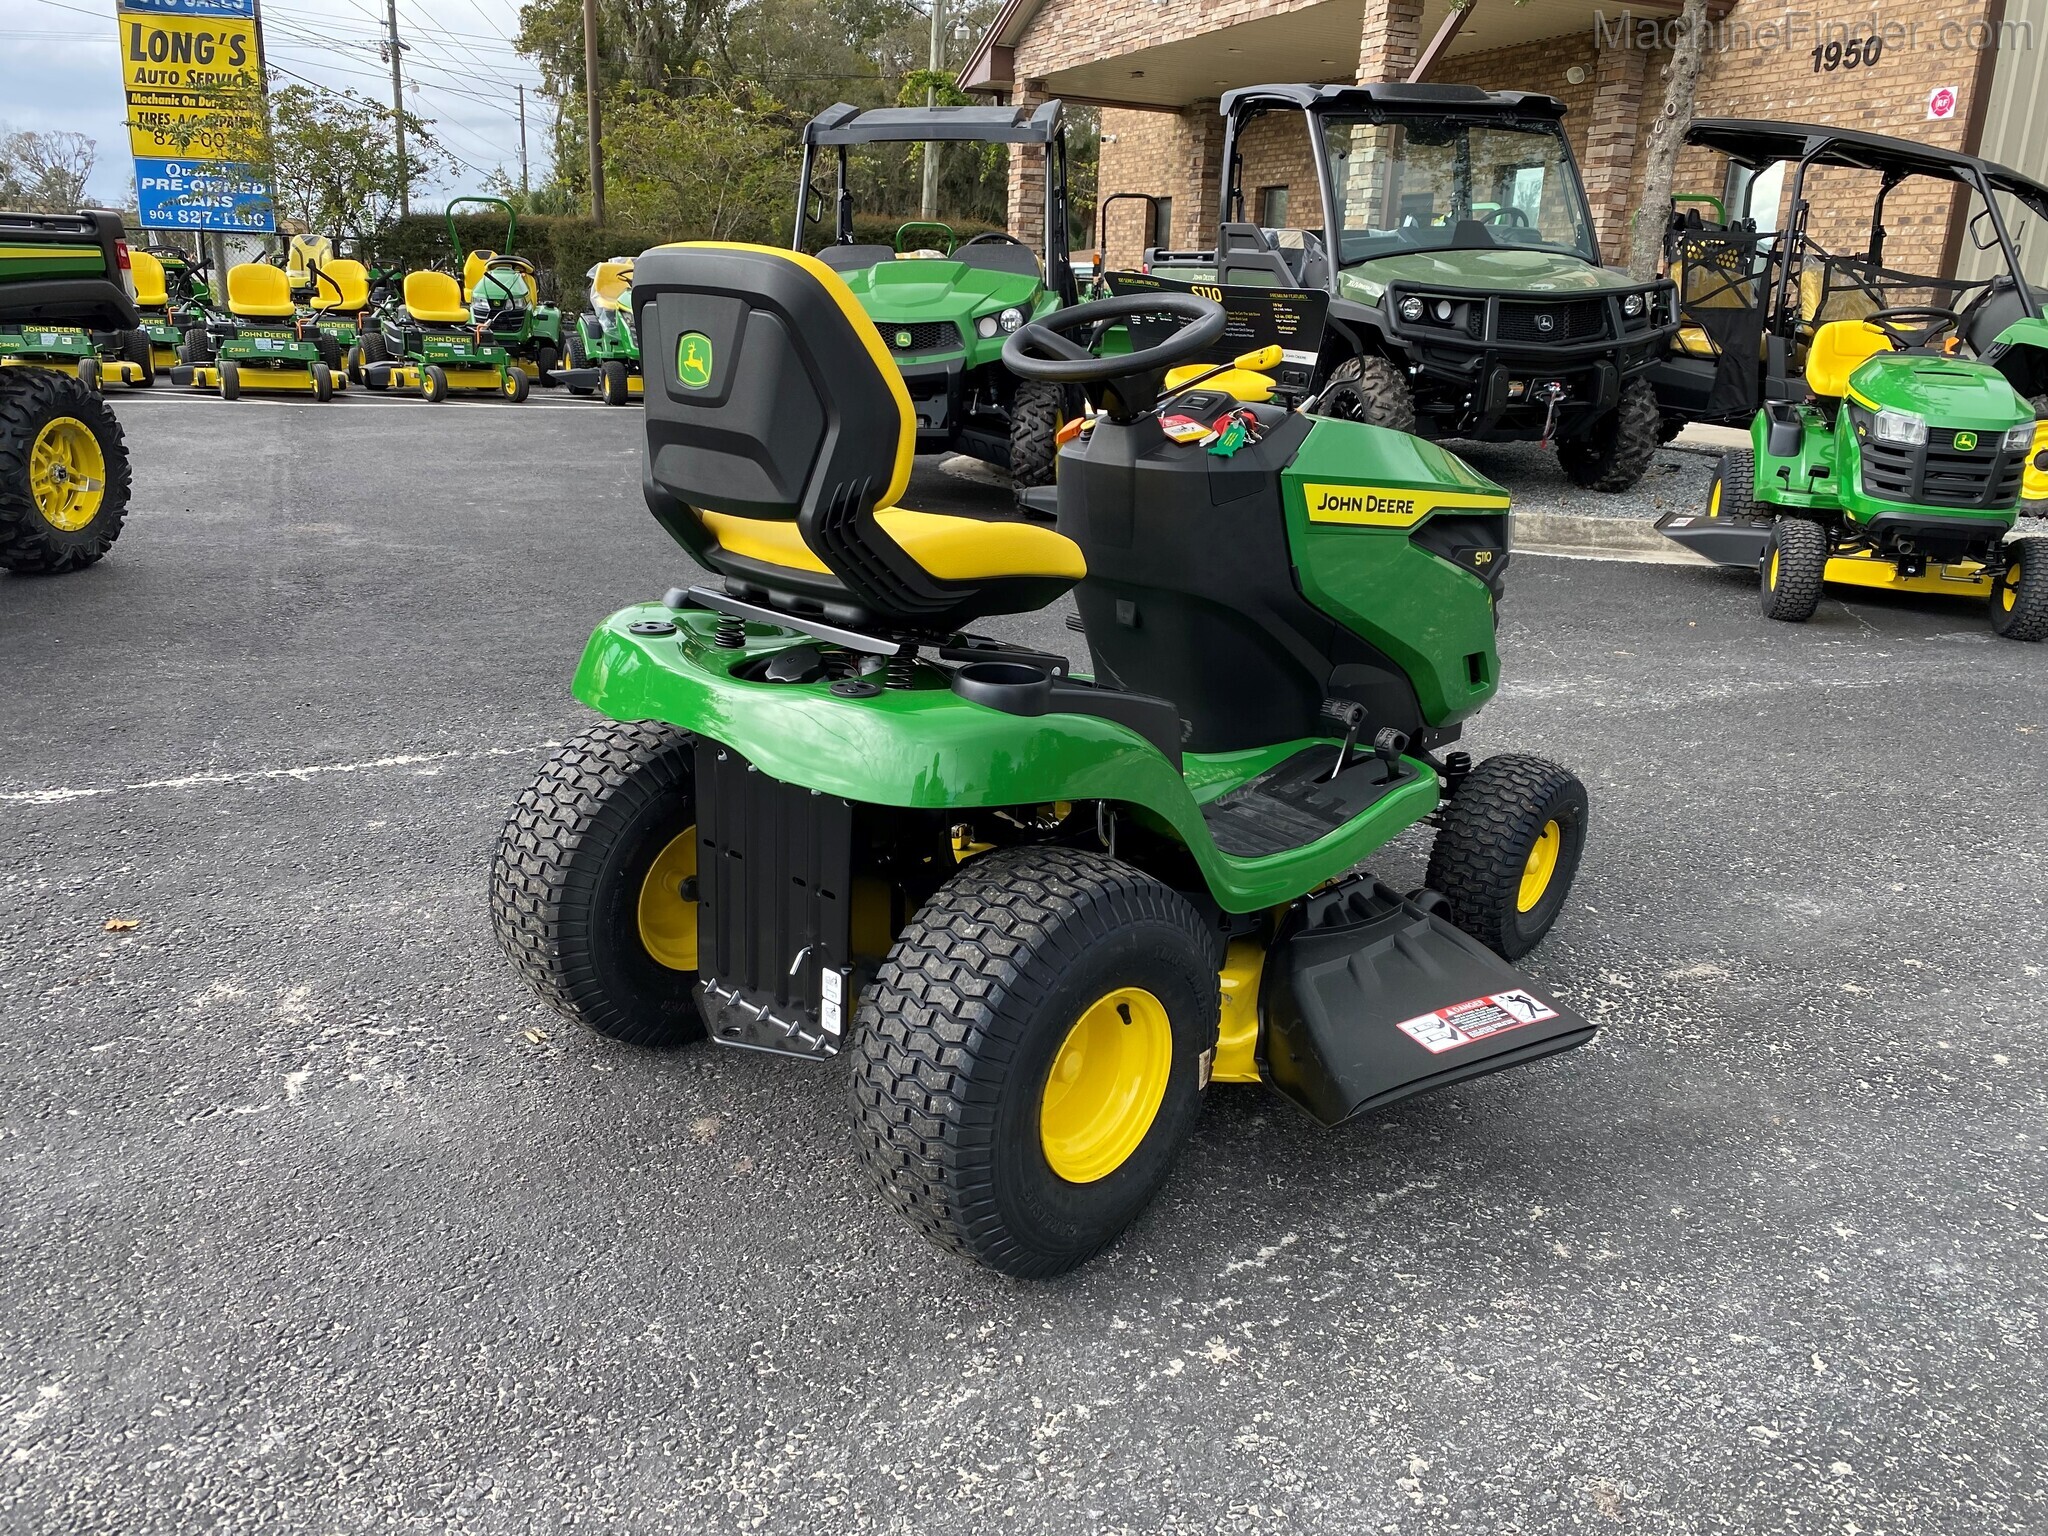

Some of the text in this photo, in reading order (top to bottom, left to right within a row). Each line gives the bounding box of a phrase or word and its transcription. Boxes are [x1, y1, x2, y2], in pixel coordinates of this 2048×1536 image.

[130, 23, 247, 67] LONG'S
[1811, 35, 1883, 73] 1950
[133, 66, 250, 89] AUTO SERVIC
[131, 93, 180, 106] Mechanic
[182, 95, 196, 107] On
[137, 111, 171, 126] TIRES
[141, 177, 266, 195] PRE-OWNED
[178, 194, 234, 208] CARS
[149, 209, 173, 220] 904
[23, 325, 82, 334] JOHN DEERE
[239, 330, 293, 339] JOHN DEERE
[1317, 492, 1415, 514] JOHN DEERE
[1475, 551, 1492, 566] S110
[1453, 999, 1487, 1013] DANGER
